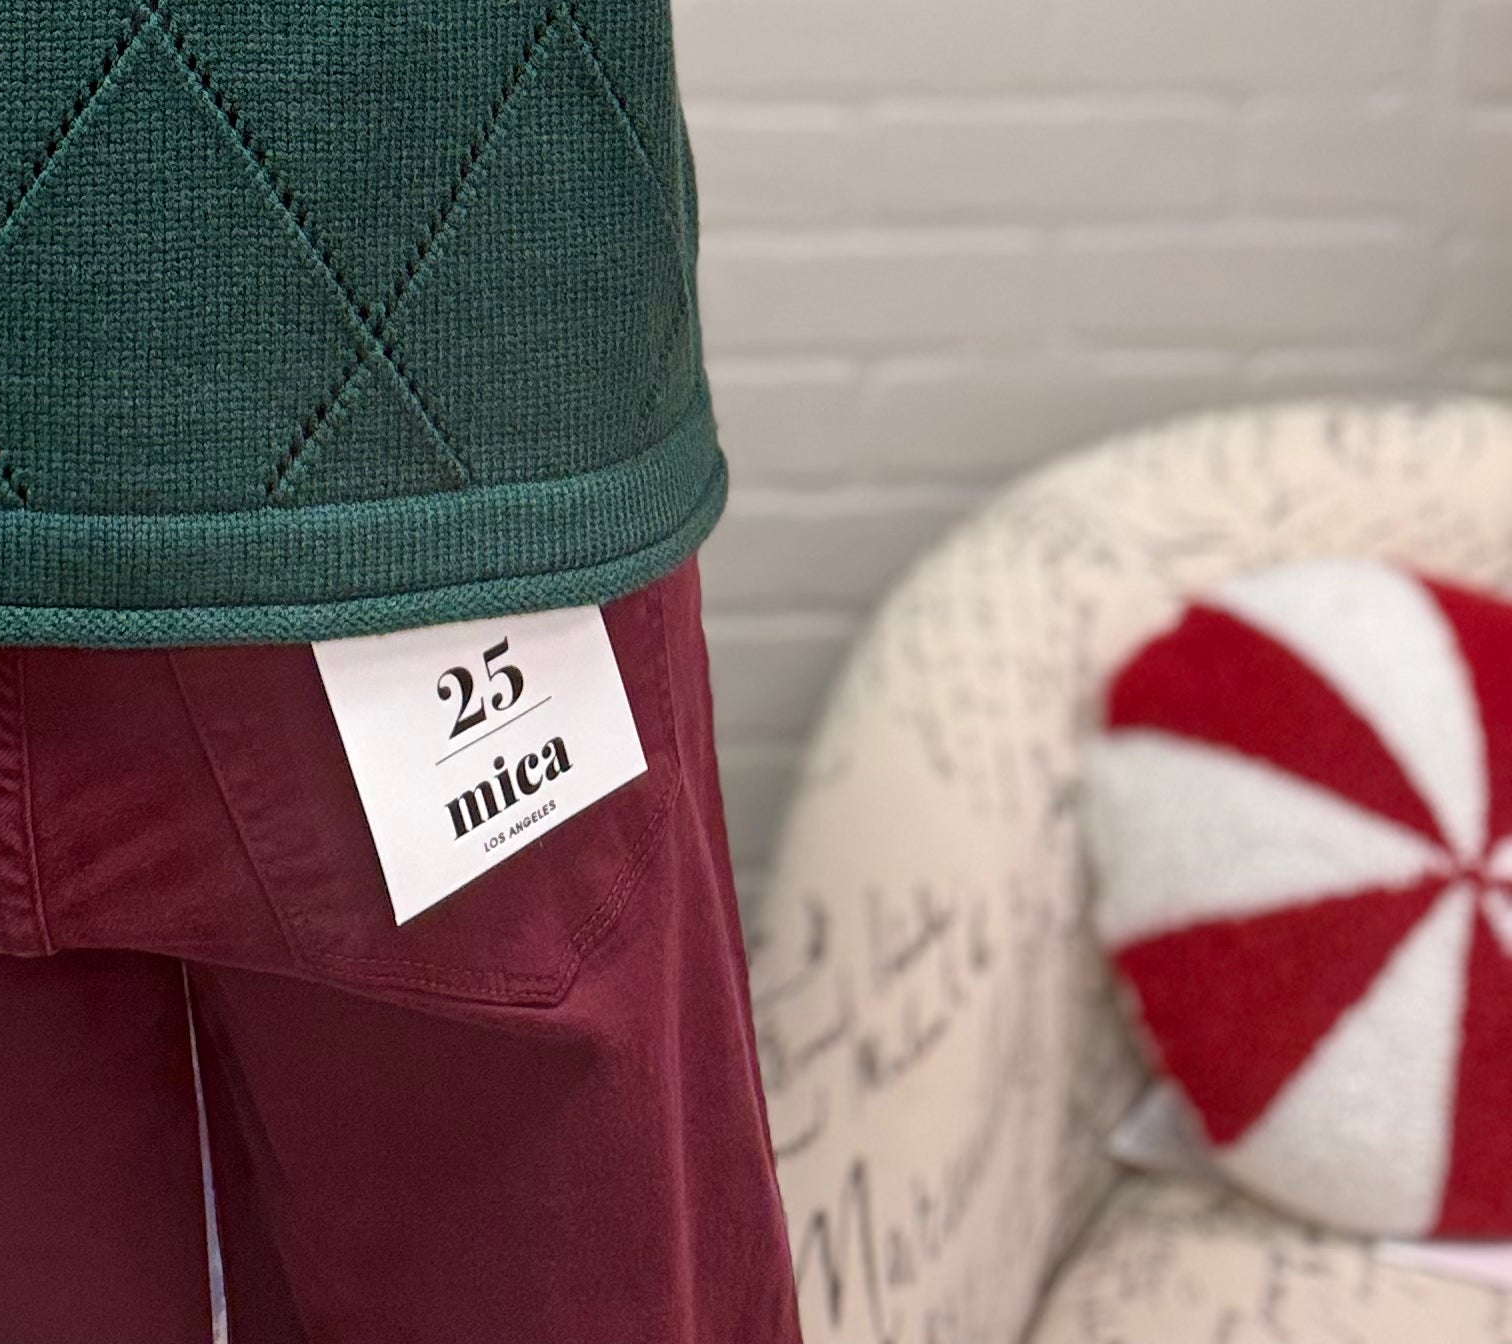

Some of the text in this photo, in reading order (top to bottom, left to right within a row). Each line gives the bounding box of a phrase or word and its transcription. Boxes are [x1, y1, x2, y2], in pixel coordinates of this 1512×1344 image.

[436, 635, 525, 740] 25
[443, 735, 574, 841] mica
[483, 799, 557, 853] LOS ANGELES
